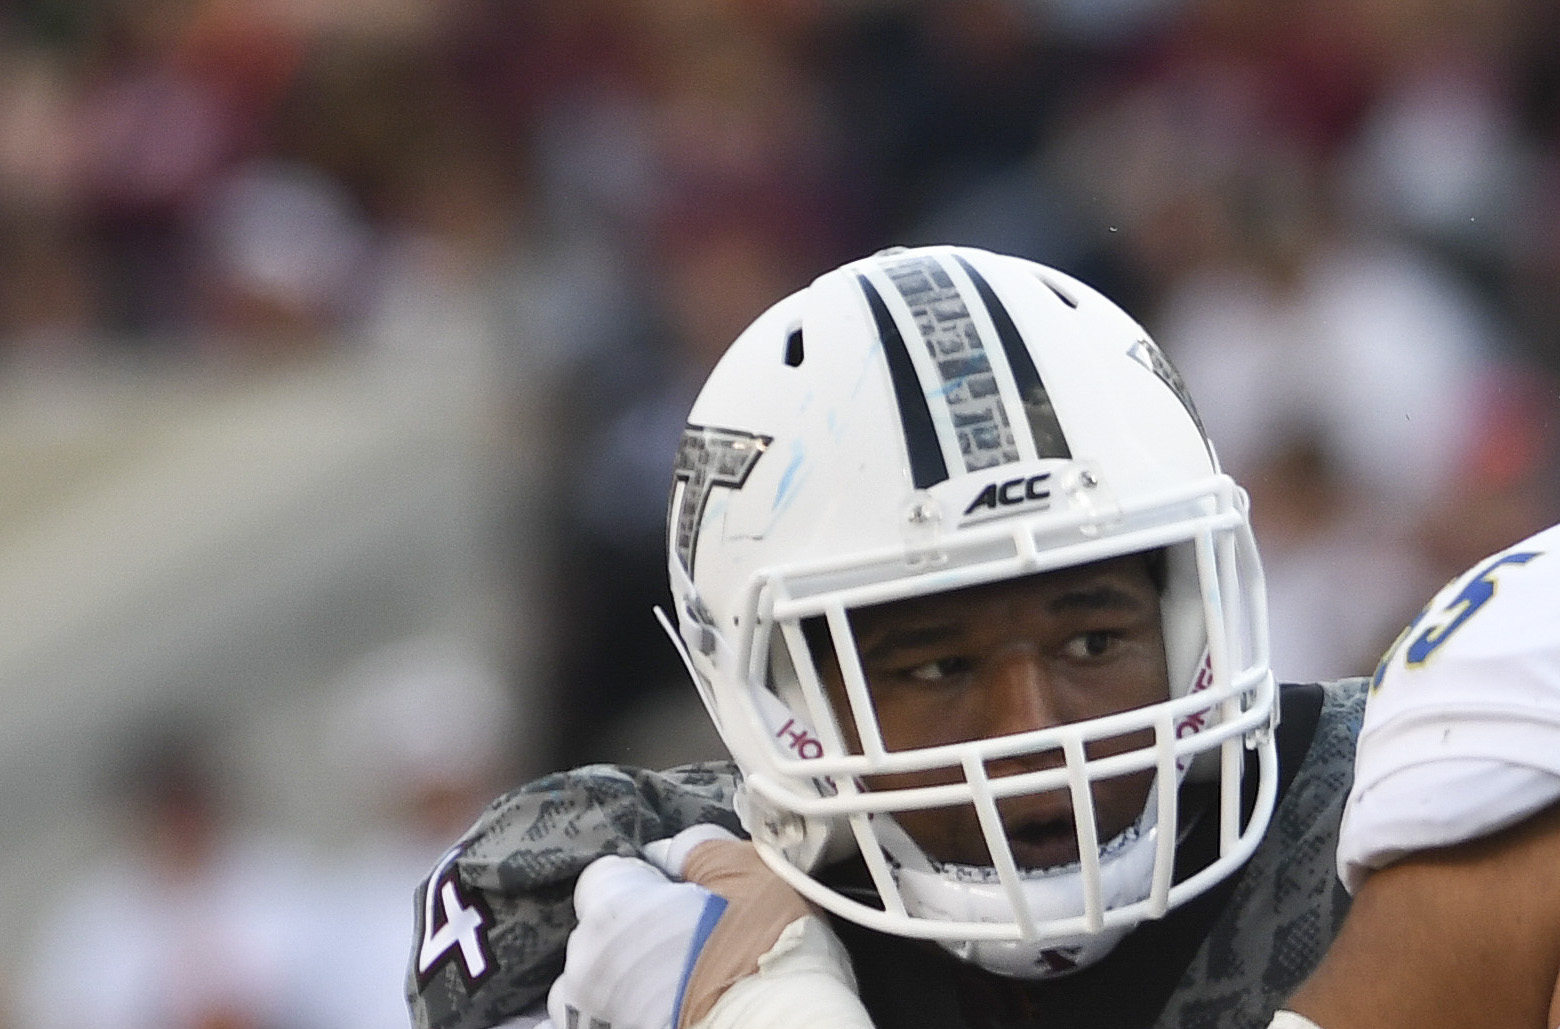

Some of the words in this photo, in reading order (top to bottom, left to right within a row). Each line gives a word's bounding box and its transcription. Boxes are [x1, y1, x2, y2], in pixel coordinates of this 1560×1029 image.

[963, 473, 1051, 516] ACC
[1371, 551, 1546, 694] 5
[418, 847, 487, 979] 4
